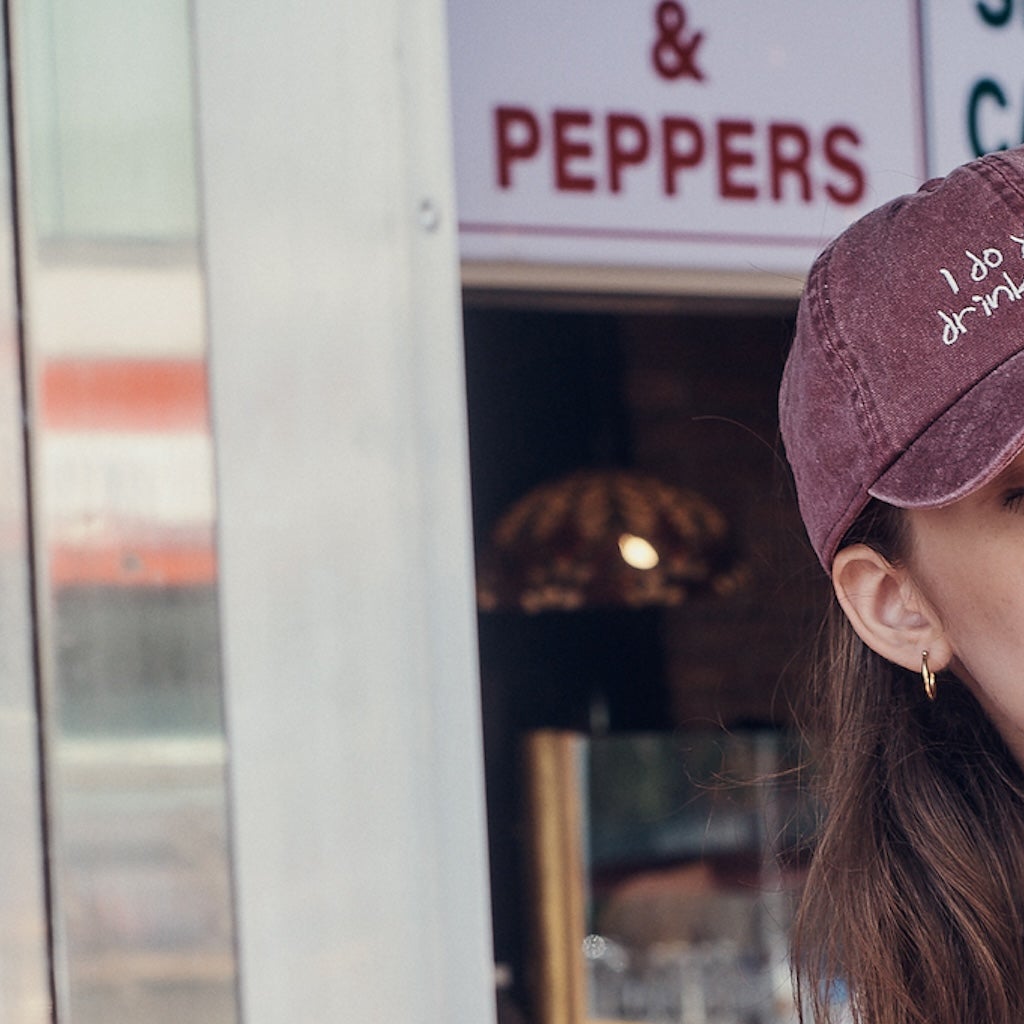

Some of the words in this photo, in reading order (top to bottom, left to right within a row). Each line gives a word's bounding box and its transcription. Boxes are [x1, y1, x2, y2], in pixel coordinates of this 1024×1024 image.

[651, 0, 706, 82] &
[493, 105, 867, 206] PEPPERS
[966, 250, 1003, 281] do
